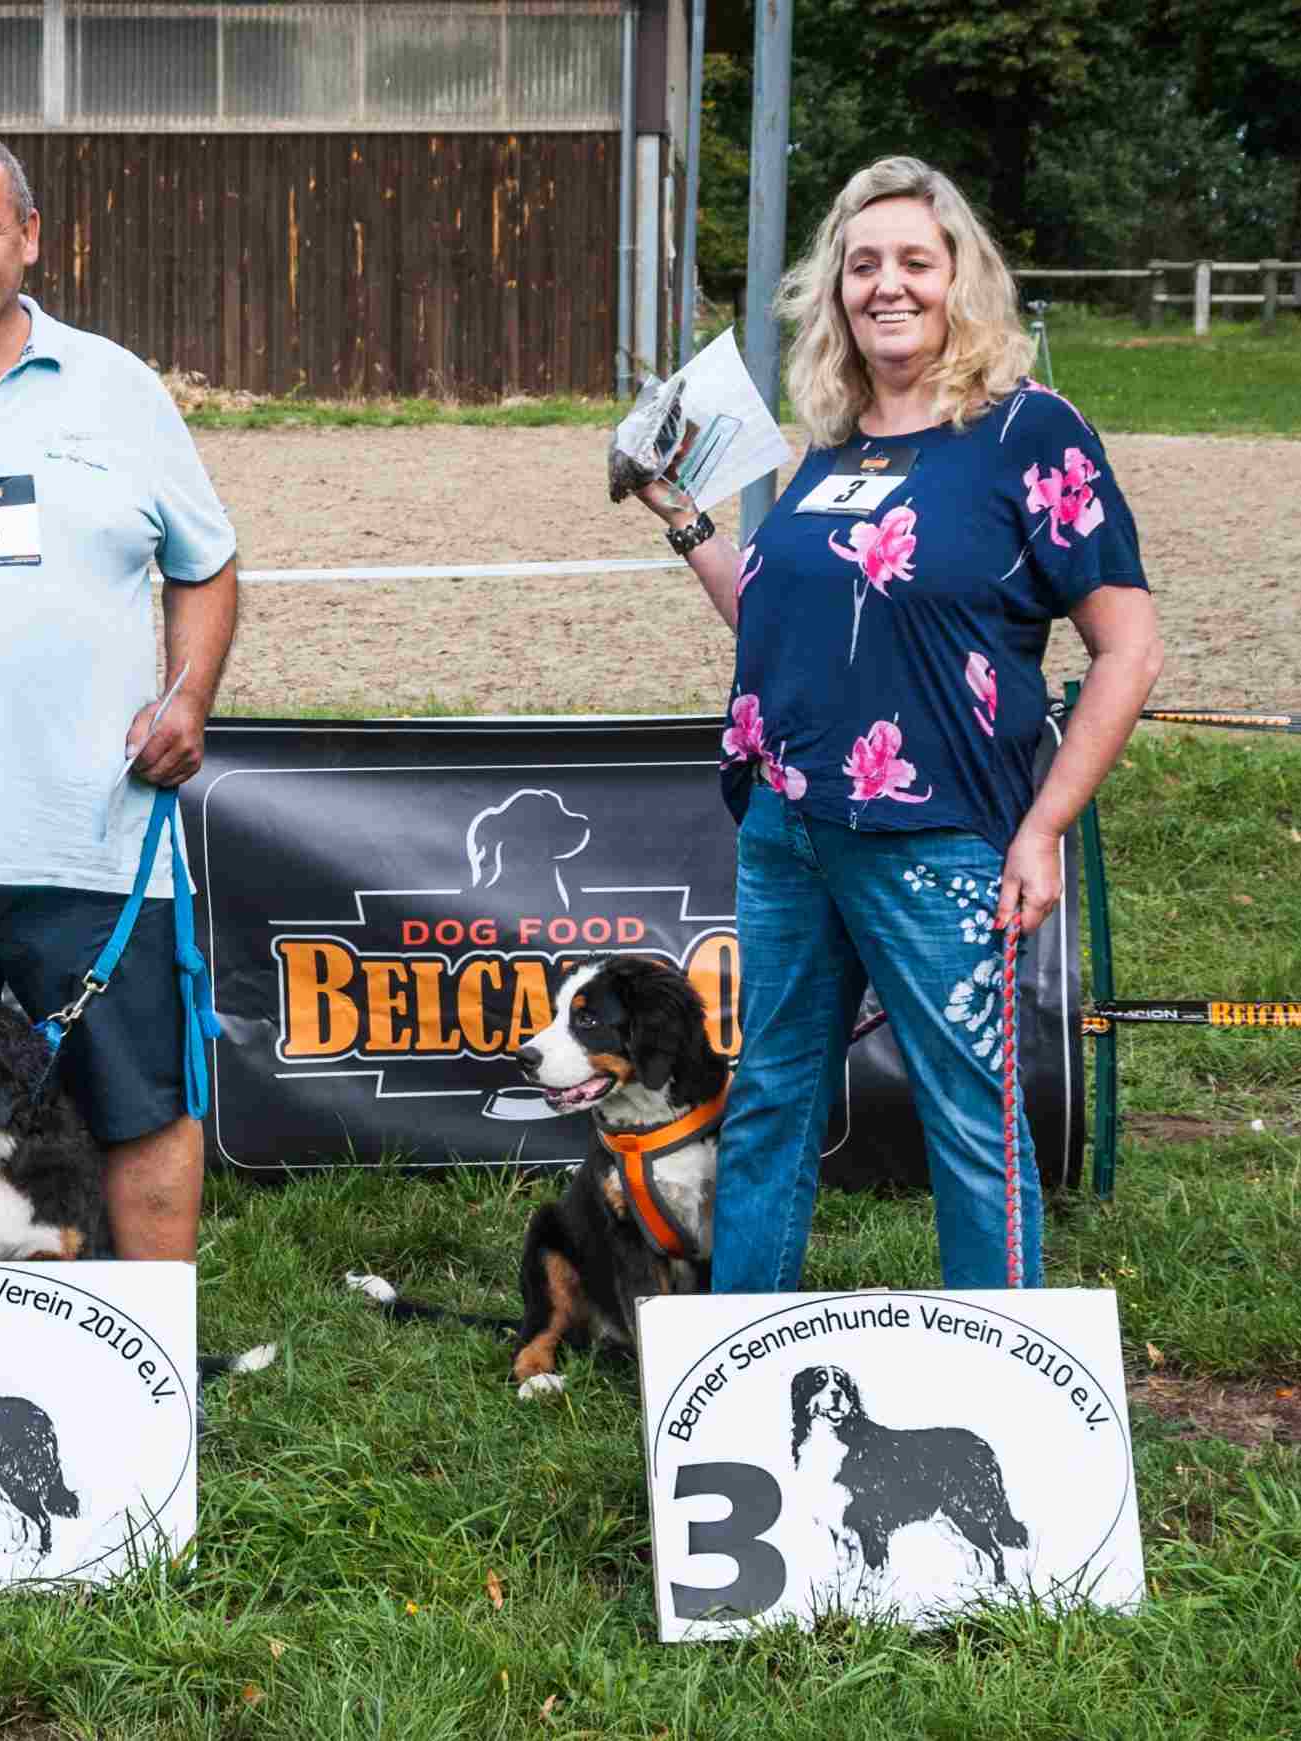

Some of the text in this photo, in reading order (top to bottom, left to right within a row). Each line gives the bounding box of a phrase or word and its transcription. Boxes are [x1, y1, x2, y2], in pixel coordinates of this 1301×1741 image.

[834, 479, 868, 503] 3
[402, 916, 646, 946] DOG FOOD
[278, 935, 743, 1057] BELCAO
[78, 1306, 144, 1361] 2010
[137, 1360, 177, 1404] e.V.
[667, 1303, 1109, 1442] Berner Sennenhunde Verein 2010 e.V.
[670, 1461, 788, 1622] 3
